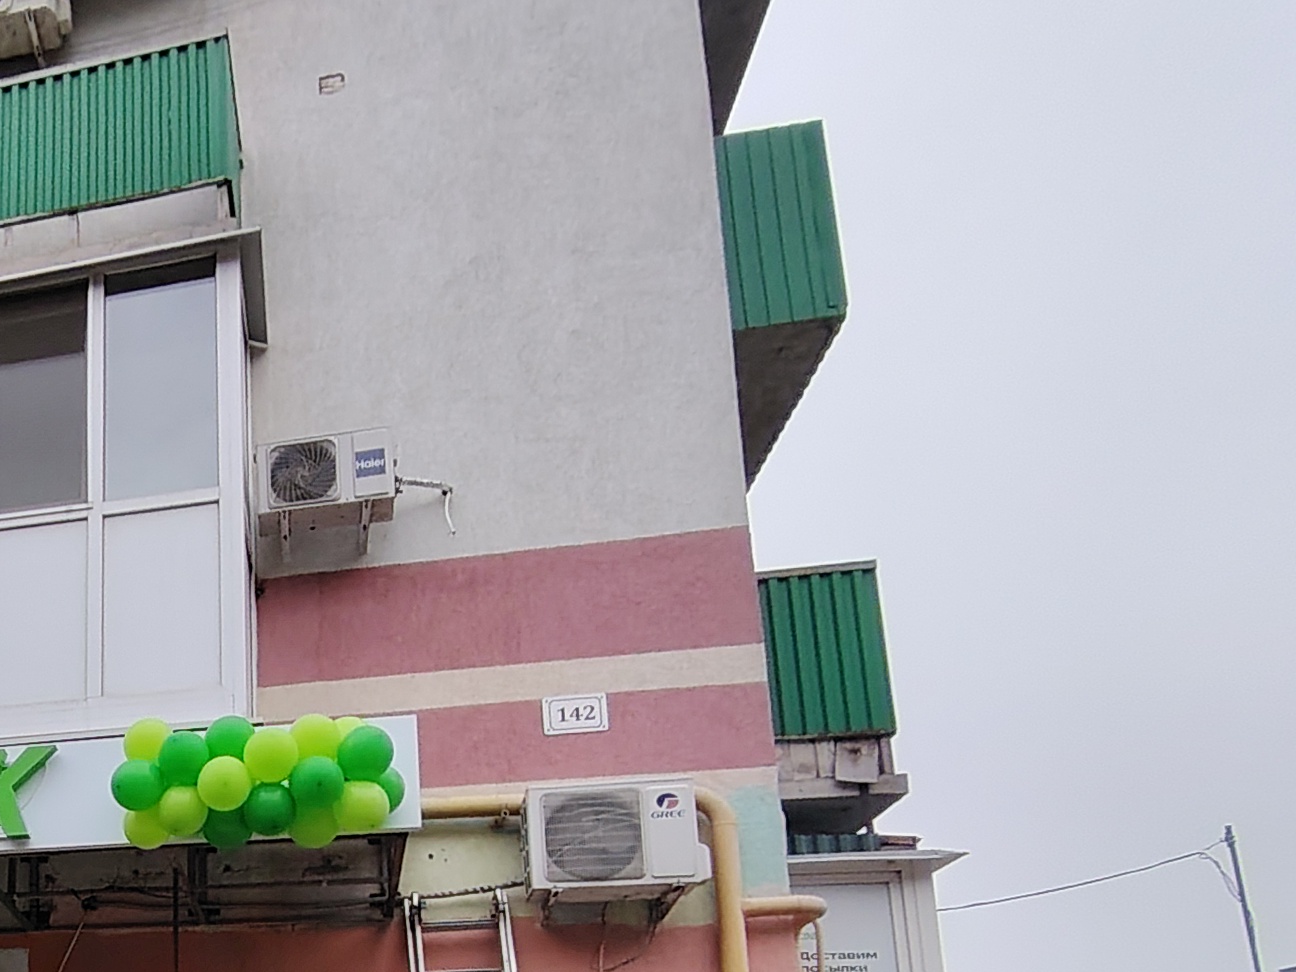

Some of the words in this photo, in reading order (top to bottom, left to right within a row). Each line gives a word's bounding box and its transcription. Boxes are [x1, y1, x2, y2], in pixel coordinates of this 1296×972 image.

[356, 458, 385, 470] Haier
[557, 705, 596, 722] 142
[651, 810, 686, 818] GREE
